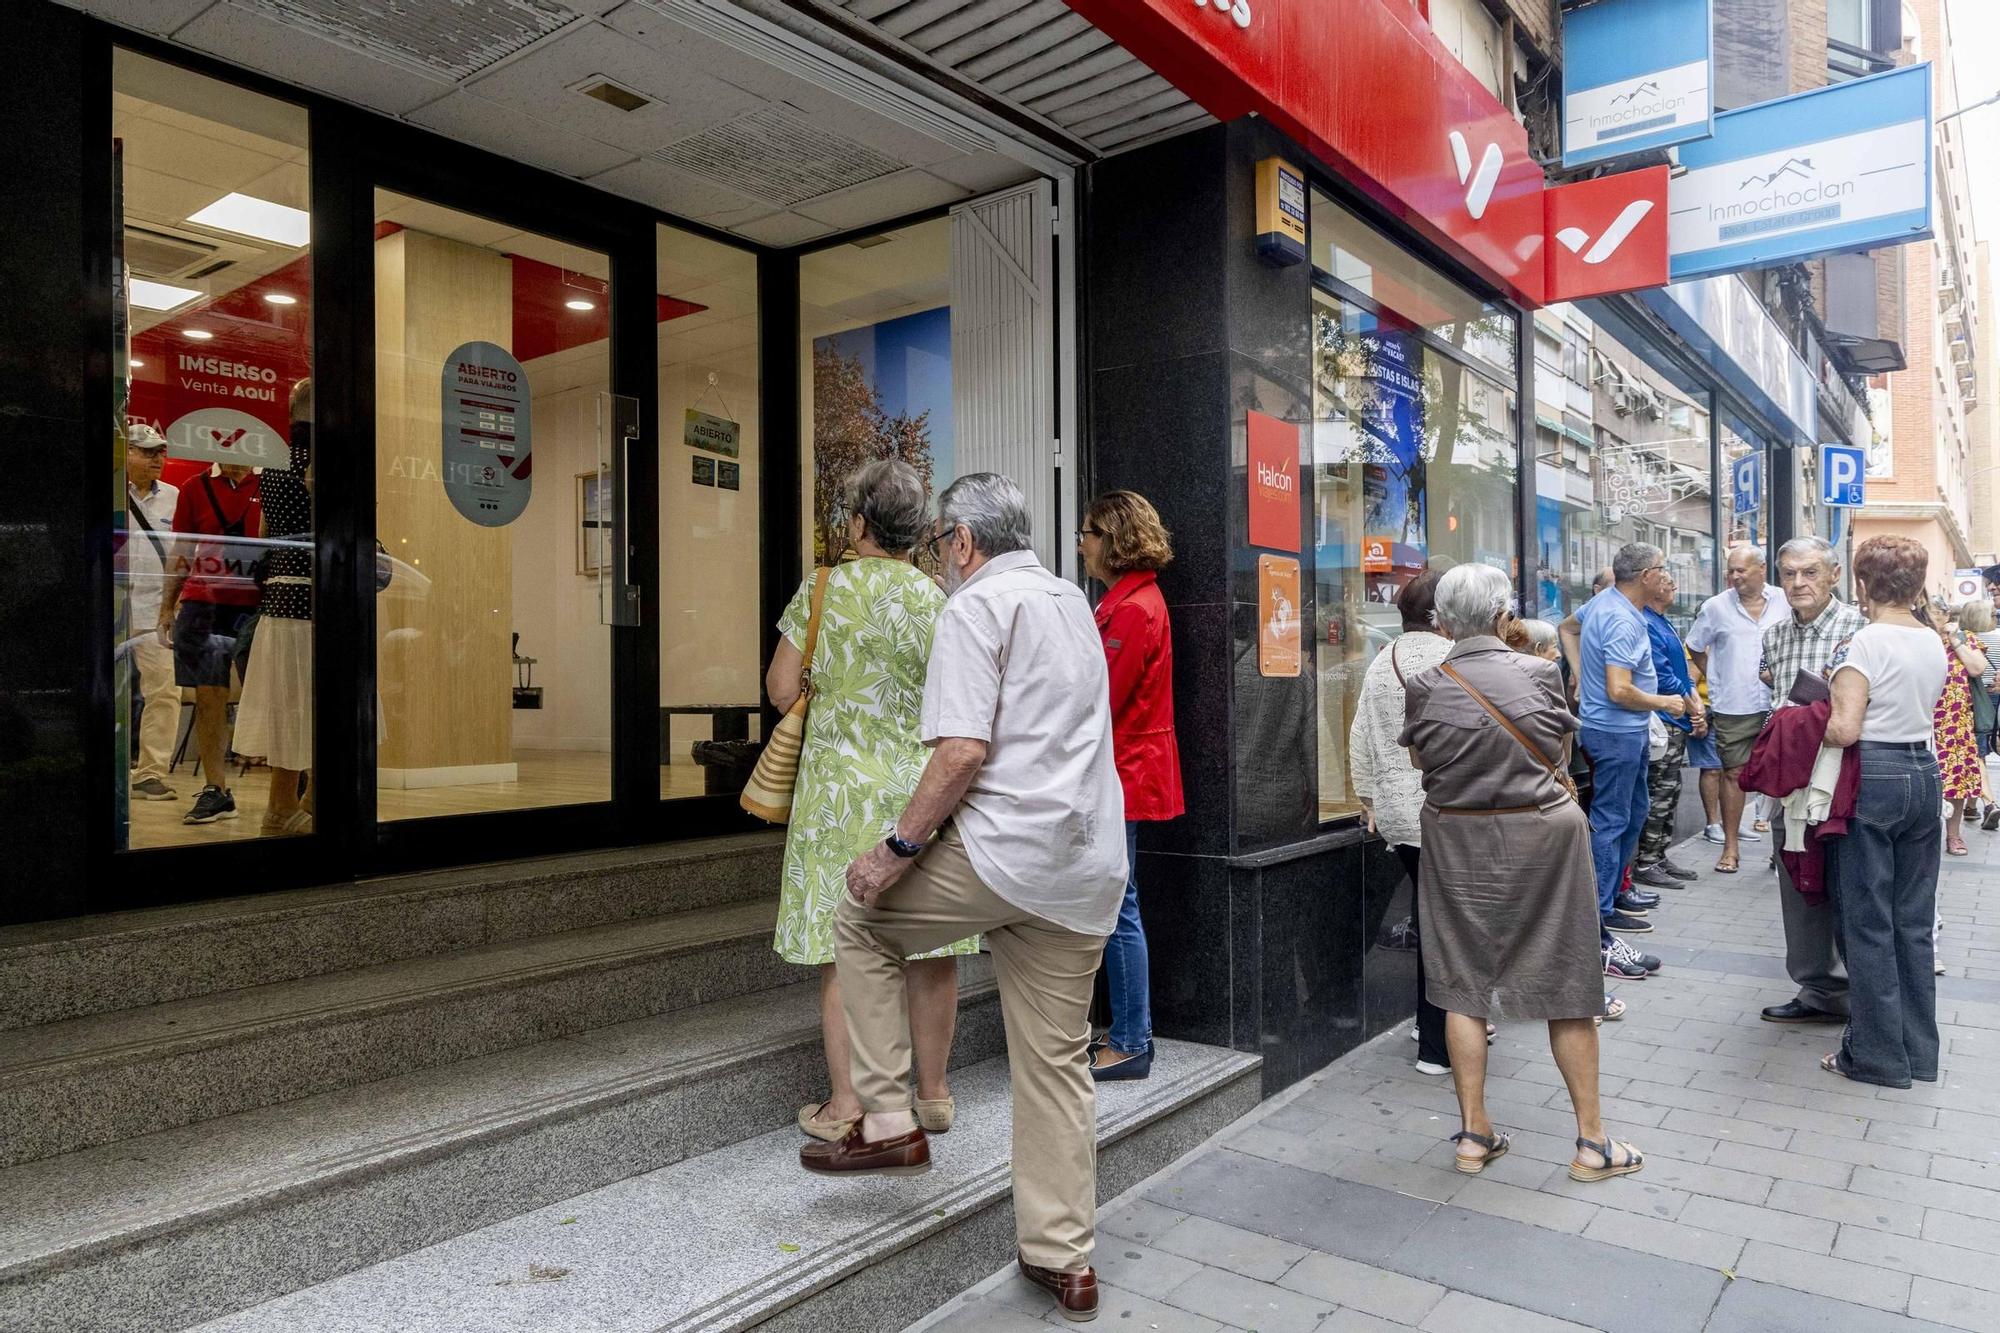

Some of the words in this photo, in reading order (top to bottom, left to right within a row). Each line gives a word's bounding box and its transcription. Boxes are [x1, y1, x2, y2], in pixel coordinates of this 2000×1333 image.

[1589, 96, 1686, 129] Inmochoclan
[1709, 180, 1855, 222] Inmochoclan
[178, 354, 277, 384] IMSERSO
[458, 362, 517, 383] ABIERTO
[1396, 372, 1401, 385] E
[1401, 375, 1420, 393] ISLAS
[180, 376, 228, 395] Venta
[233, 385, 276, 402] AQUÍ
[458, 375, 479, 386] PARA
[481, 380, 517, 392] VIAJEROS
[693, 425, 732, 444] ABIERTO
[1257, 457, 1292, 492] Halcón
[1831, 452, 1857, 499] P
